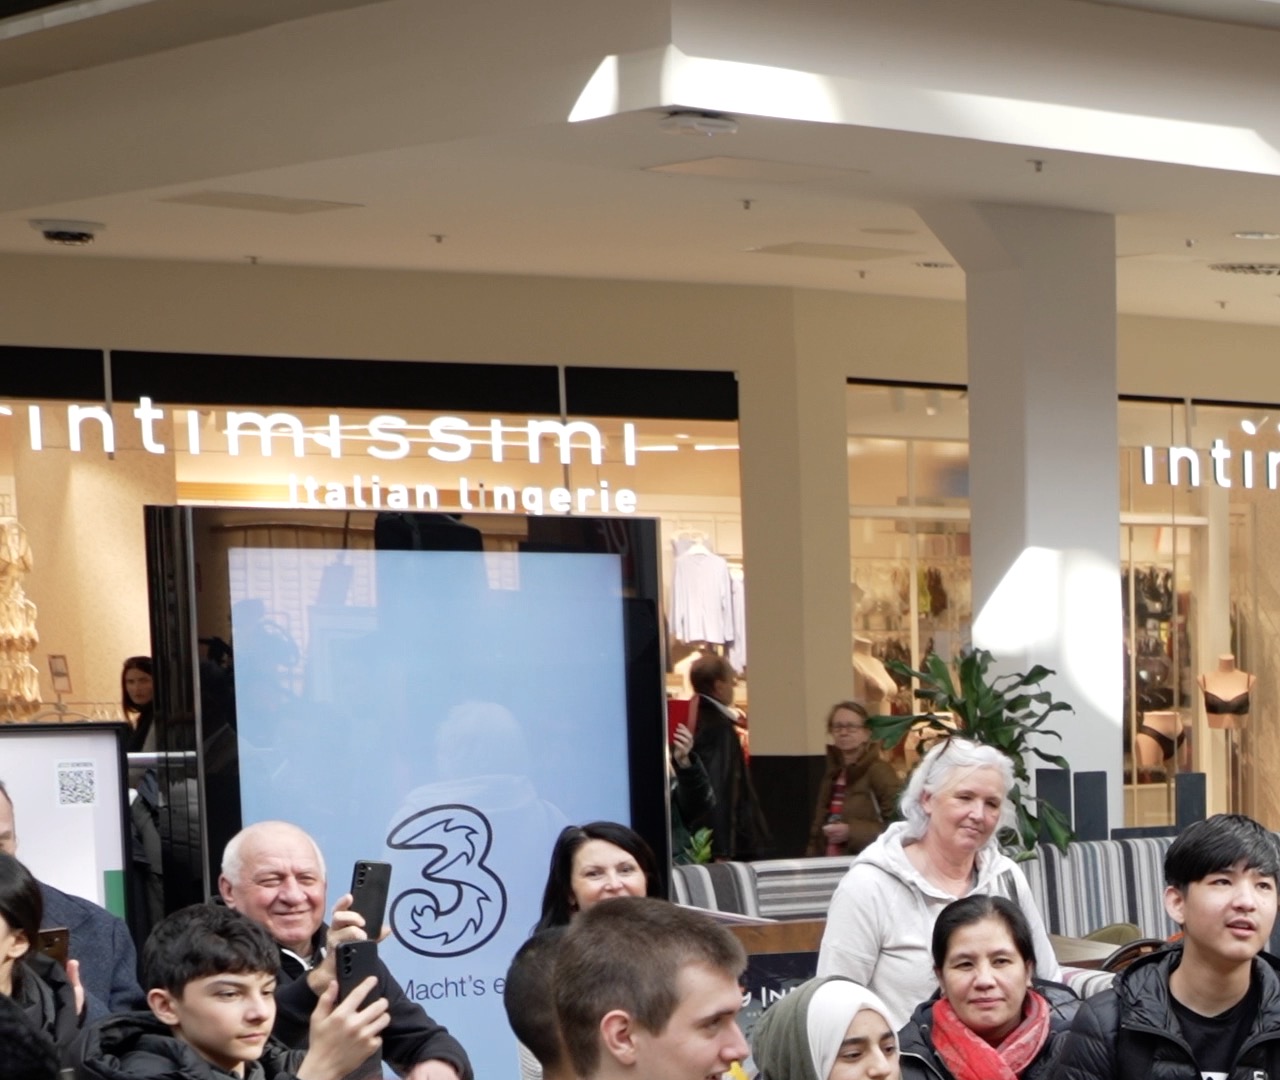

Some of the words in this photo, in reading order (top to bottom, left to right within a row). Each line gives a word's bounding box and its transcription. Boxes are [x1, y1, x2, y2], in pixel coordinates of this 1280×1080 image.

[28, 397, 637, 466] intimissimi
[288, 474, 439, 510] Italian
[459, 477, 638, 515] lingerie
